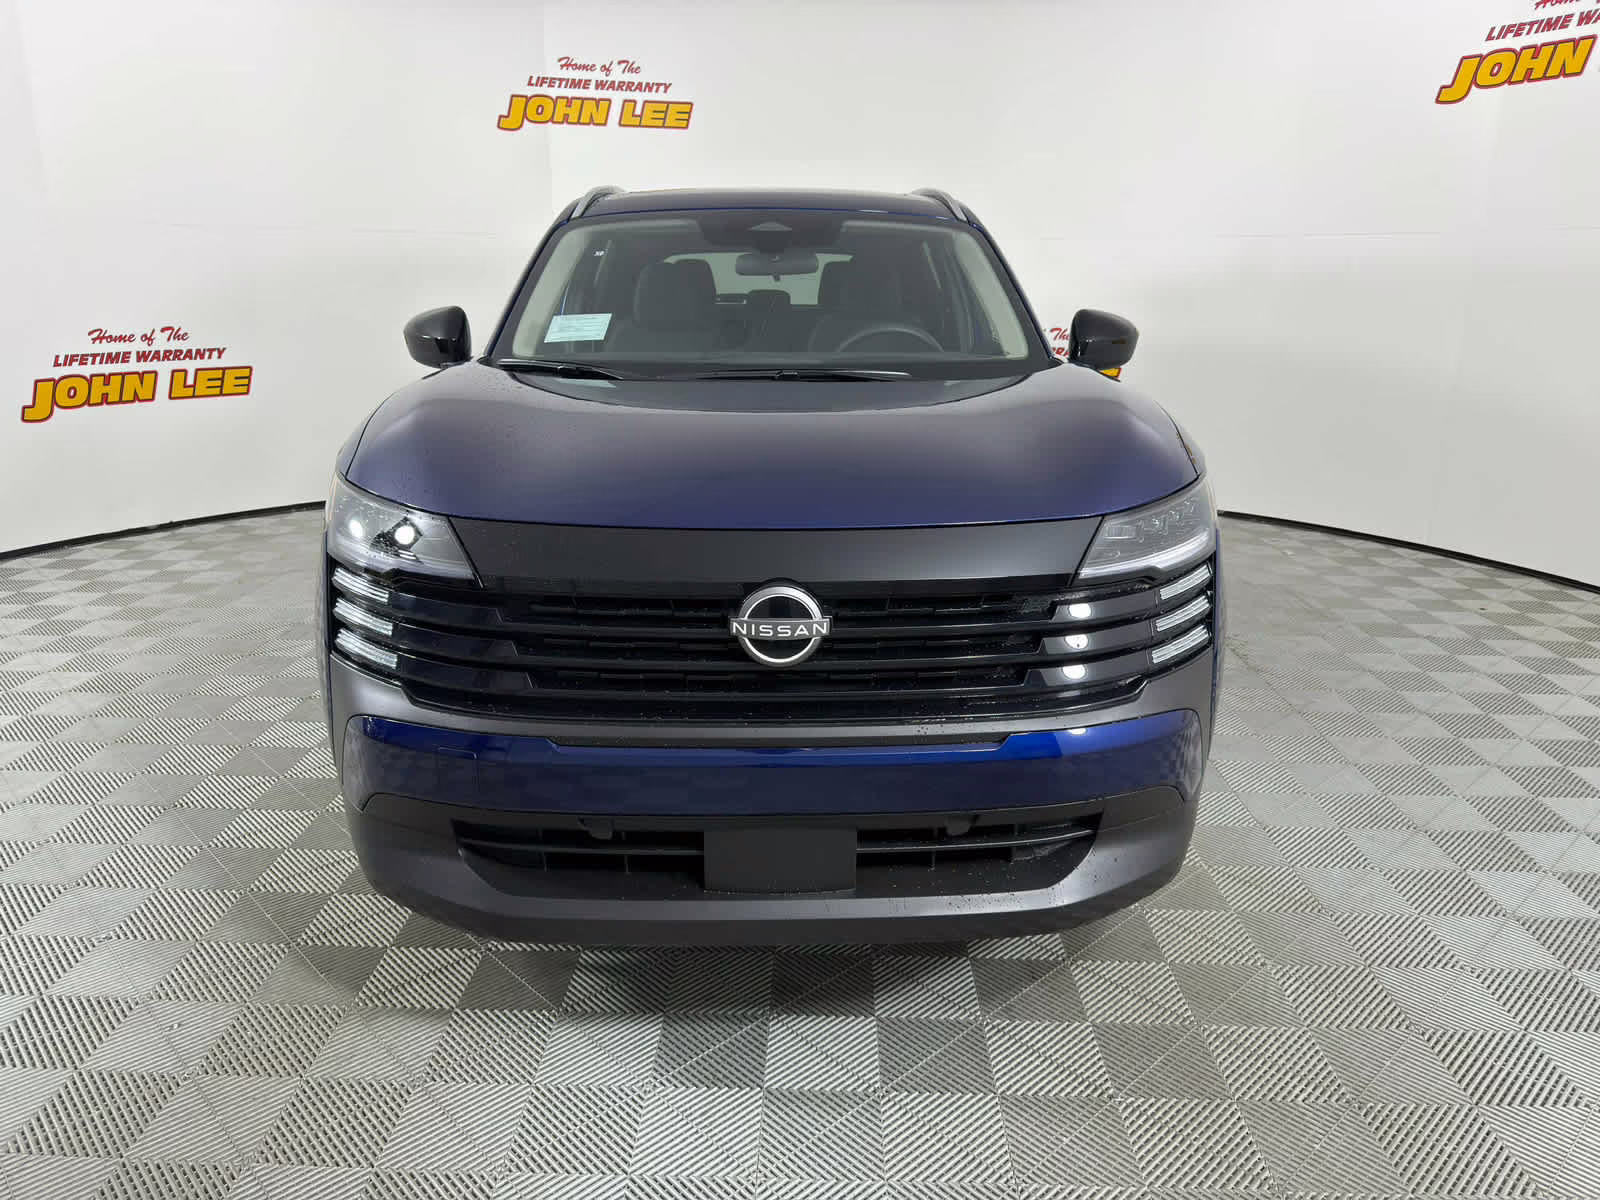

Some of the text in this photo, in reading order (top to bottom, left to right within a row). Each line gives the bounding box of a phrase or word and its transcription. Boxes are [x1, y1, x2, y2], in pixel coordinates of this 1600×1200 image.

[1485, 13, 1575, 41] LIFETIME
[557, 56, 641, 76] Home of The
[1435, 34, 1598, 104] JOHN
[527, 75, 672, 94] LIFETIME WARRANTY
[497, 94, 693, 131] JOHN LEE
[88, 326, 189, 346] Home of The
[53, 347, 227, 367] LIFETIME WARRANTY
[21, 366, 253, 423] JOHN LEE
[732, 622, 828, 637] NISSAN
